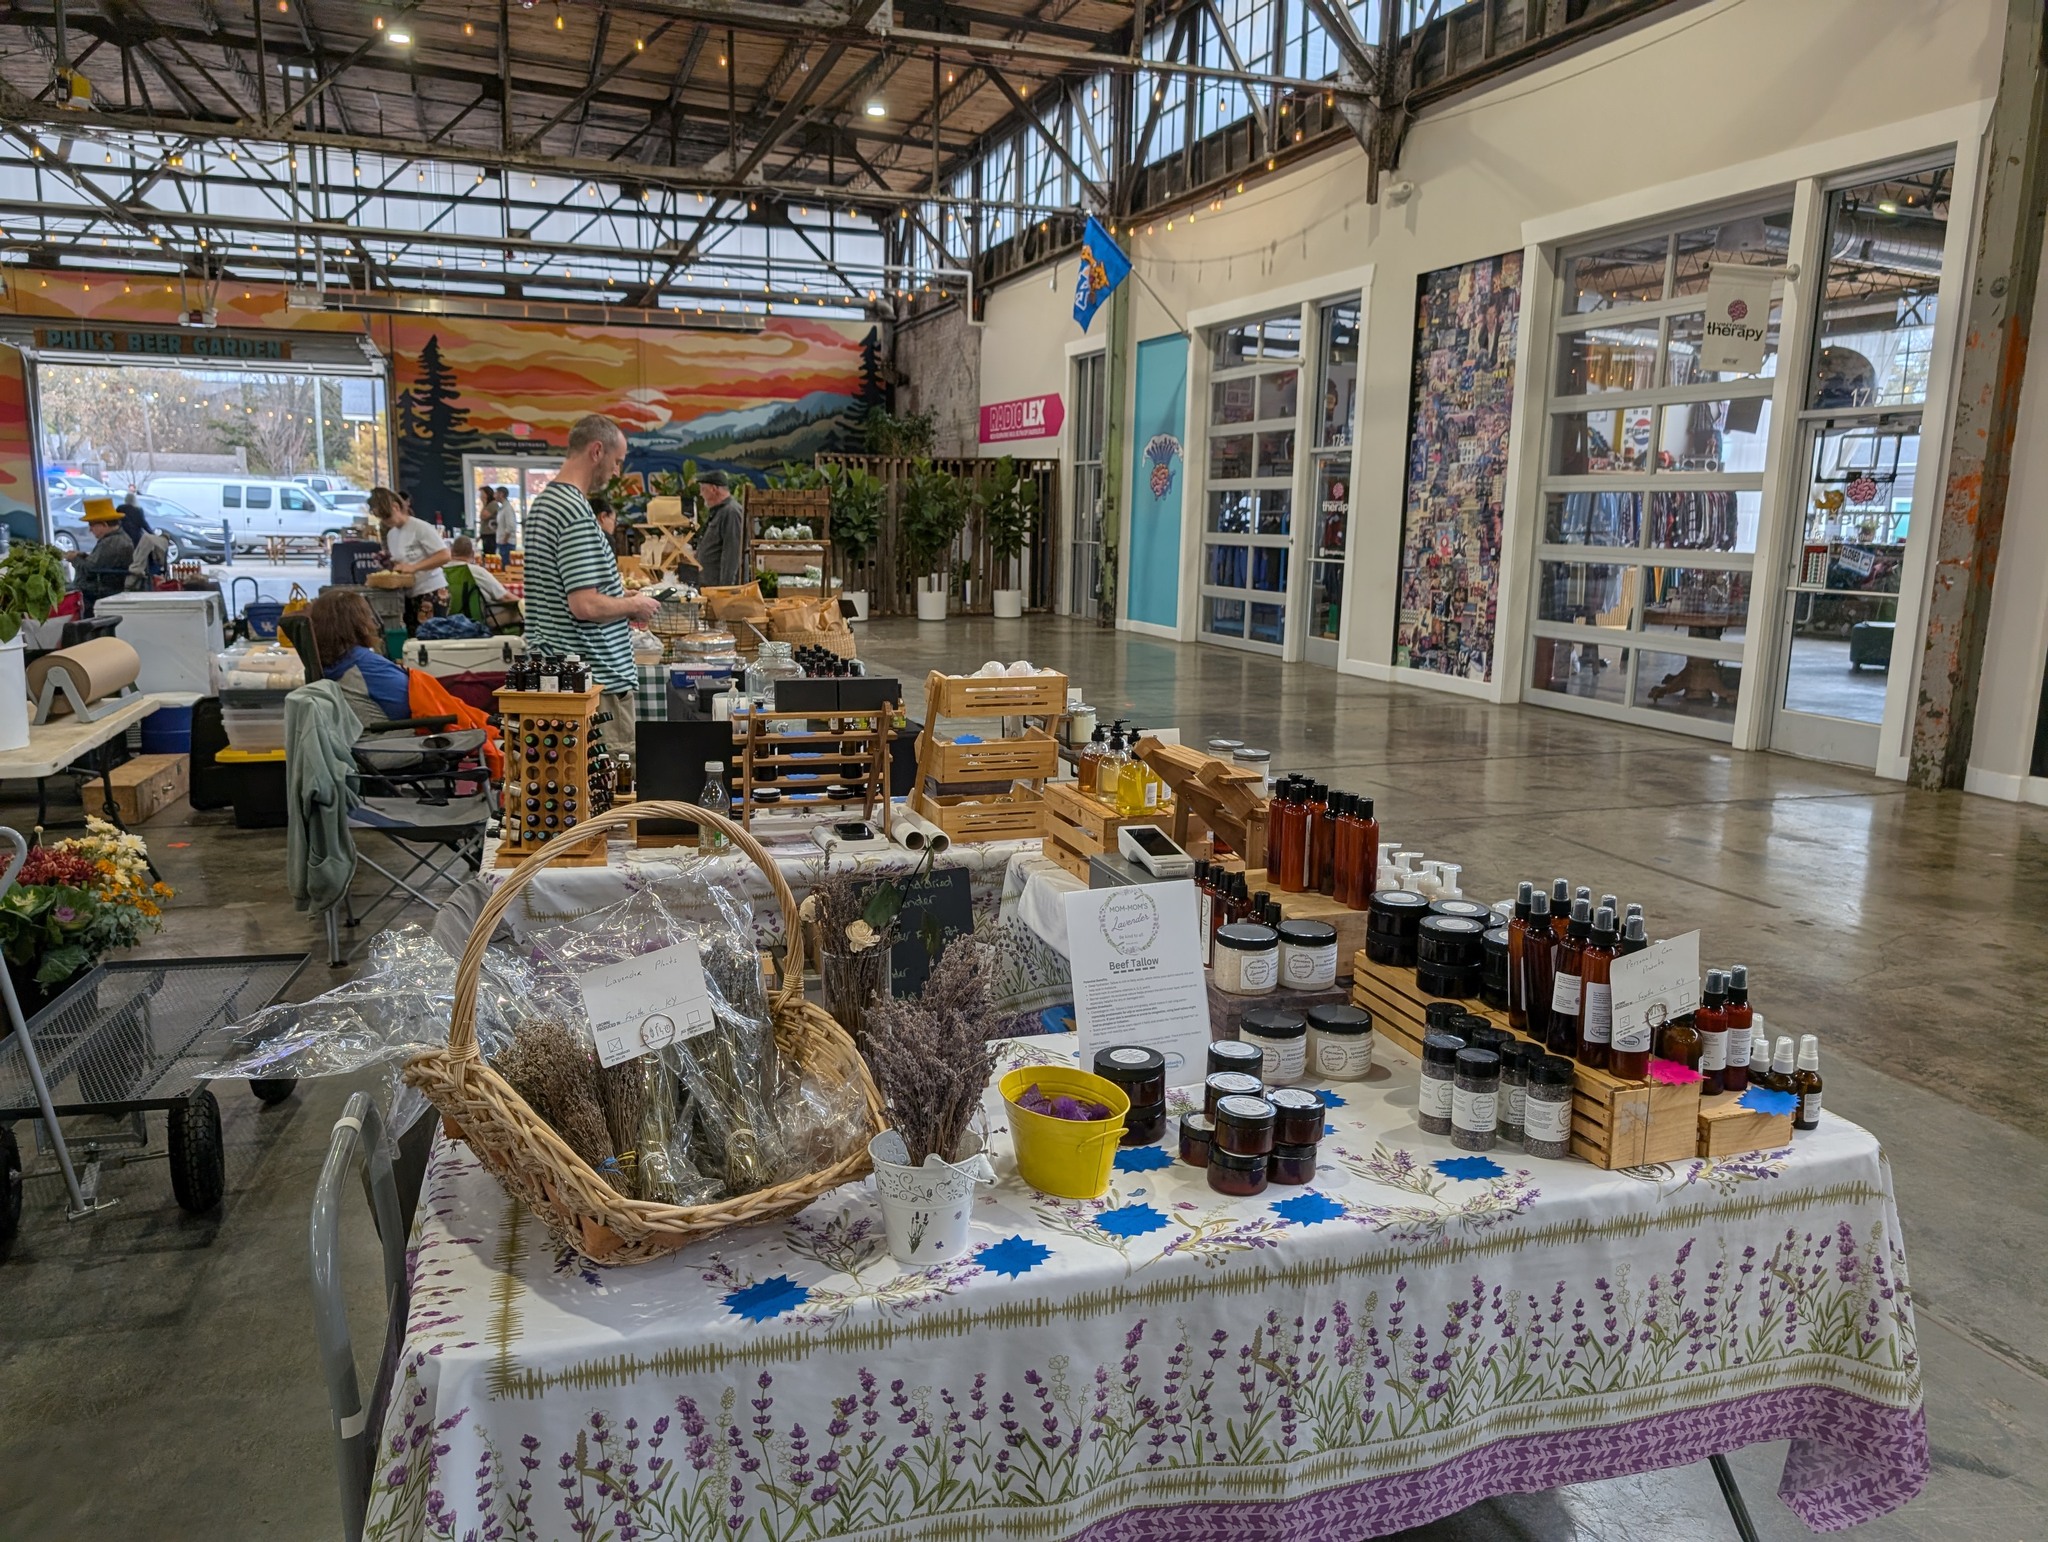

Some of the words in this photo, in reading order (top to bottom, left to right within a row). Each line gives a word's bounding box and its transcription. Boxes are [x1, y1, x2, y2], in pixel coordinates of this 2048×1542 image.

[1707, 322, 1763, 342] therapy
[46, 329, 115, 350] PHIL'S
[128, 333, 182, 354] BEER
[193, 336, 282, 358] GARDEN
[1332, 434, 1345, 447] 178
[1322, 501, 1349, 514] therap
[1842, 547, 1861, 563] CLOSED
[1109, 902, 1149, 913] MOM-MOM'S
[1111, 912, 1150, 932] Lavender
[1109, 960, 1130, 971] Beef
[1131, 956, 1159, 968] Tallow
